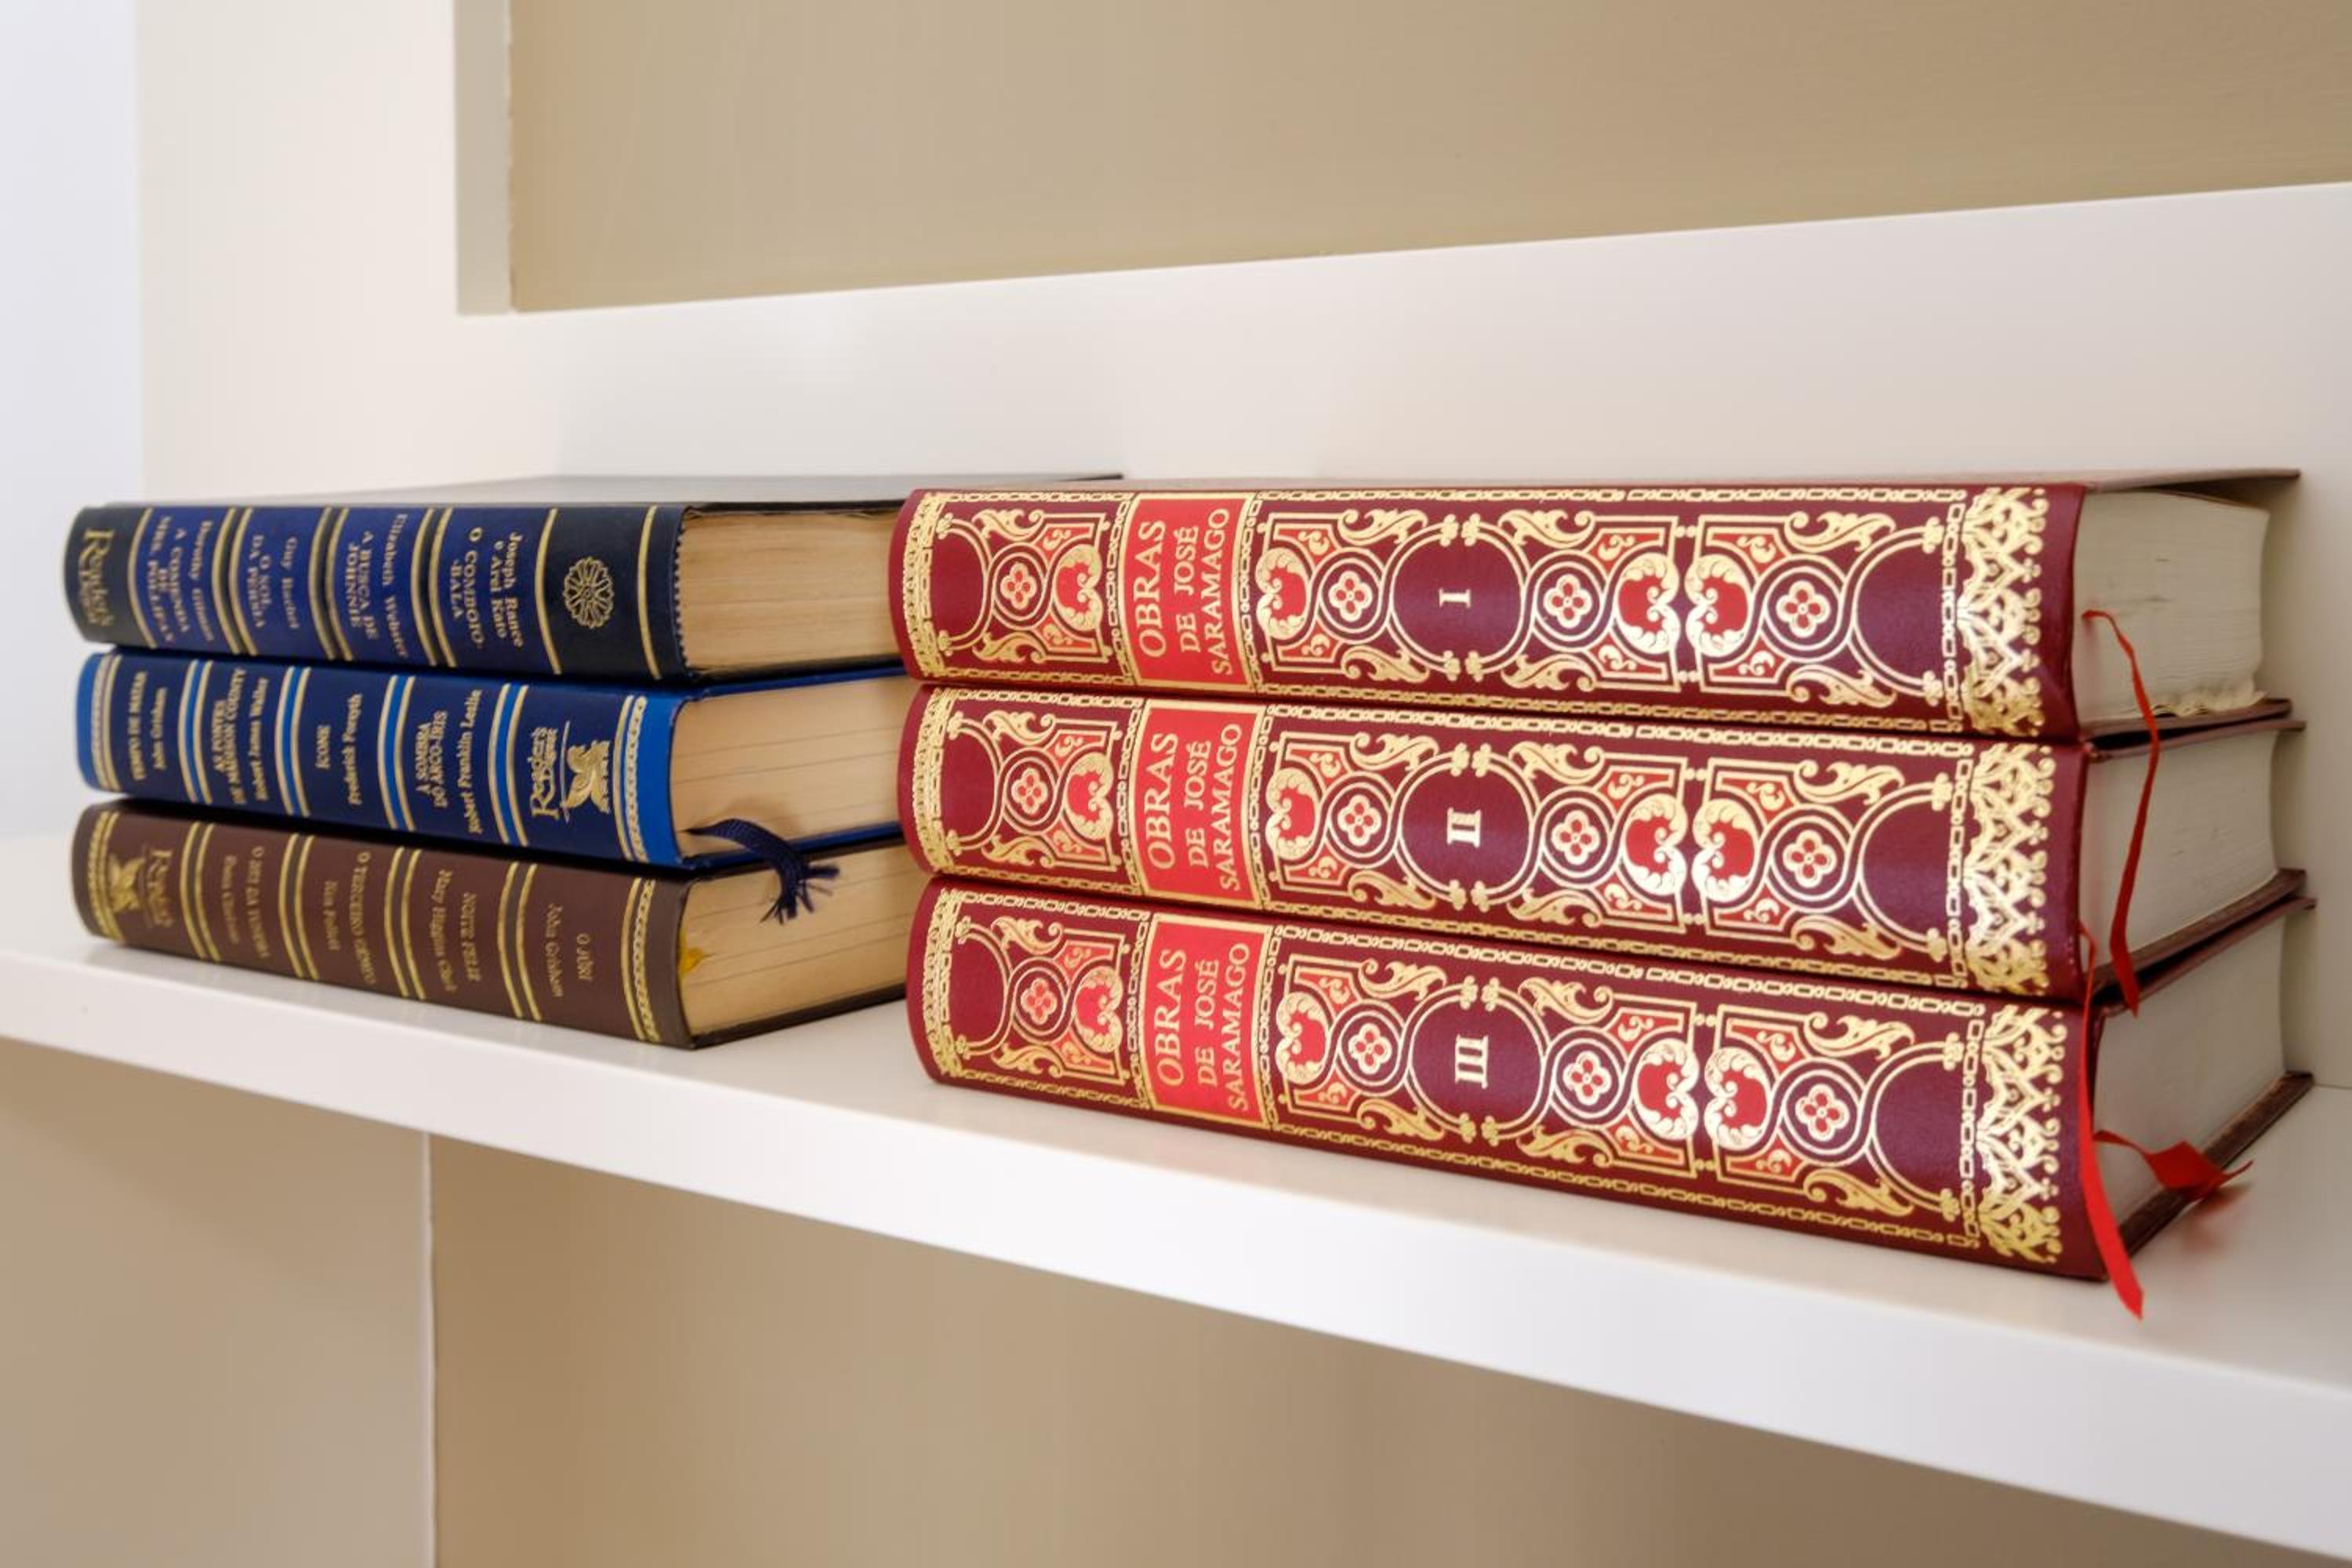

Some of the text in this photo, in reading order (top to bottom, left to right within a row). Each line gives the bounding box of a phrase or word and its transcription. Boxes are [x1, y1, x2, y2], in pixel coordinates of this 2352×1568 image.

[175, 527, 188, 541] A
[249, 534, 265, 560] DA
[259, 554, 272, 570] O
[281, 536, 298, 571] Guy
[382, 514, 408, 586] Elizabeth
[468, 526, 484, 543] O
[494, 539, 506, 551] e
[345, 542, 361, 628] JOHNNIE
[358, 549, 373, 611] BUSCA
[502, 531, 525, 648] Joseph Rance
[1132, 518, 1167, 659] OBRAS
[1173, 524, 1202, 654] DE JOSÉ
[1200, 507, 1234, 677] SARAMAGO
[1439, 588, 1472, 608] I
[362, 615, 379, 641] DE
[491, 597, 508, 639] Kato
[223, 667, 248, 720] COUNTY
[459, 688, 484, 728] Leslie
[223, 722, 241, 784] MADISON
[341, 693, 364, 805] Frederick Forsyth
[414, 720, 432, 796] A SOMBRA
[456, 730, 474, 789] Franklin
[430, 785, 449, 808] DO
[1144, 732, 1179, 870] OBRAS
[1184, 739, 1212, 869] DE JOSÉ
[1210, 723, 1243, 892] SARAMAGO
[1446, 806, 1482, 849] II
[358, 851, 372, 864] O
[576, 932, 590, 946] O
[1153, 949, 1187, 1087] OBRAS
[1194, 959, 1220, 1087] DE JOSÉ
[1221, 942, 1251, 1112] SARAMAGO
[1454, 1033, 1489, 1090] III
